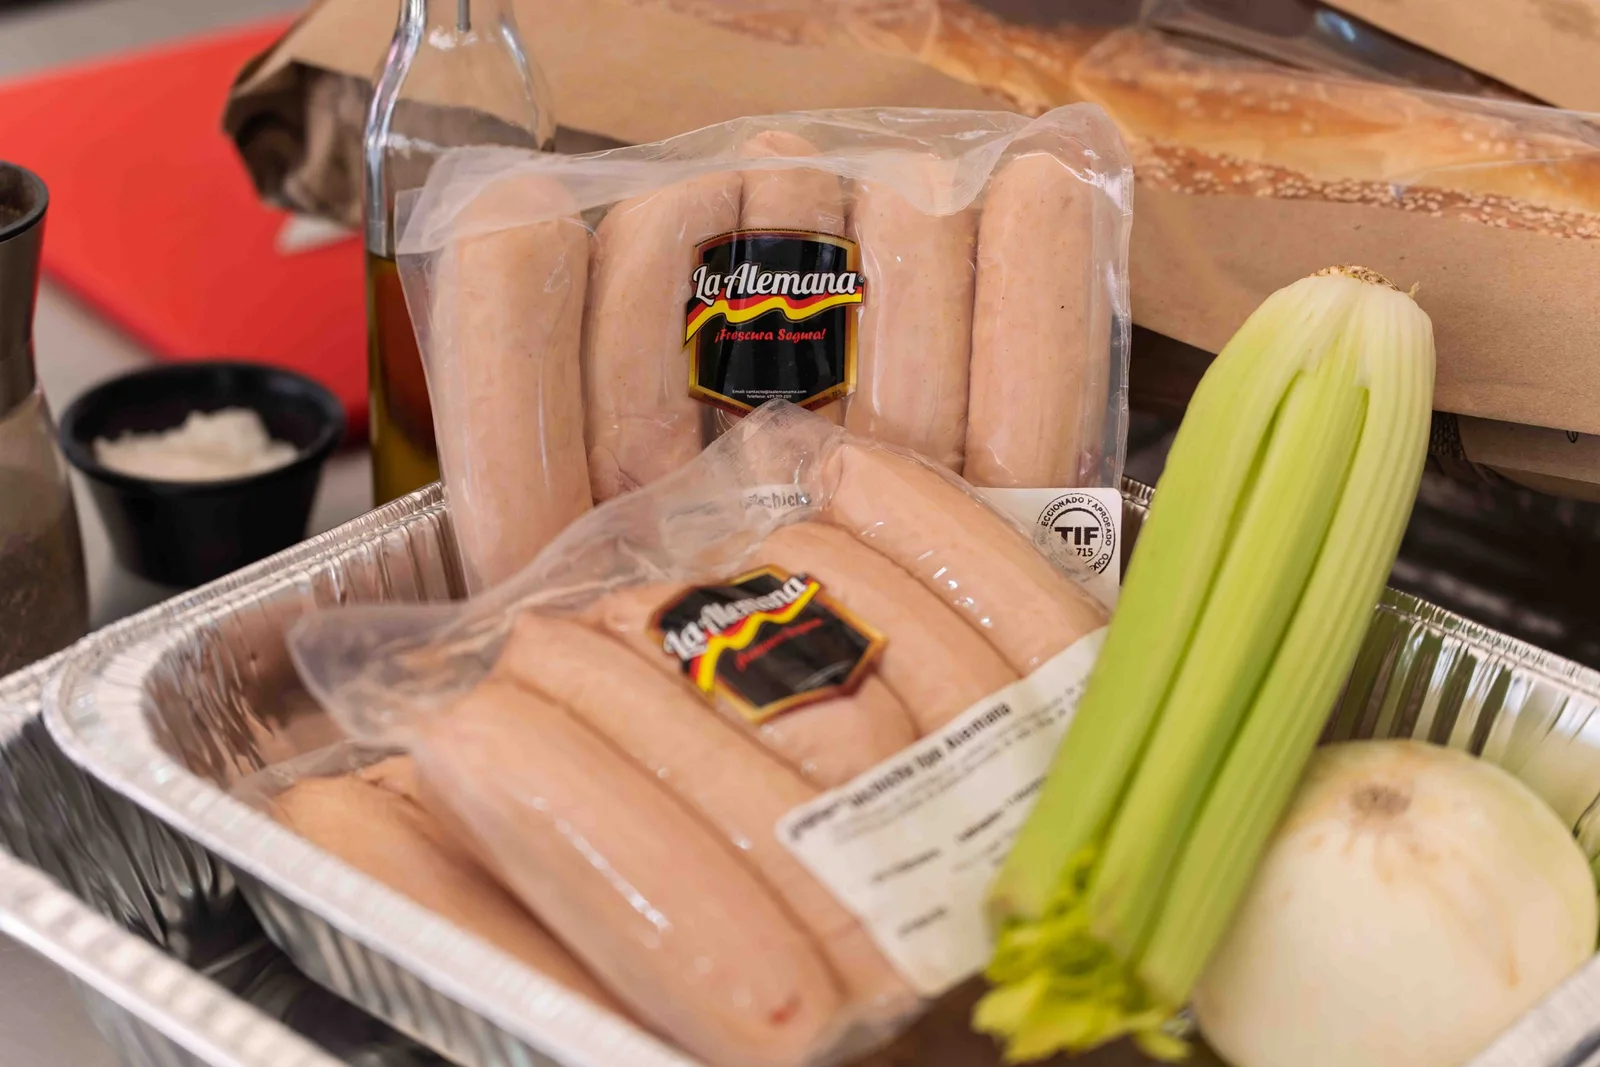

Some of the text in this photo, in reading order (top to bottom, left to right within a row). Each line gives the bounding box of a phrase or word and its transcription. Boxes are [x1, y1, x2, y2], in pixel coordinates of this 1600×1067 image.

[693, 262, 856, 306] La Alemana
[715, 328, 826, 344] ¡Frescura Segura!
[1041, 497, 1111, 546] ECCIONADO Y APROBADO
[1054, 527, 1099, 545] TIF
[1076, 548, 1093, 557] 715
[1089, 553, 1109, 571] XICO
[663, 621, 708, 660] La
